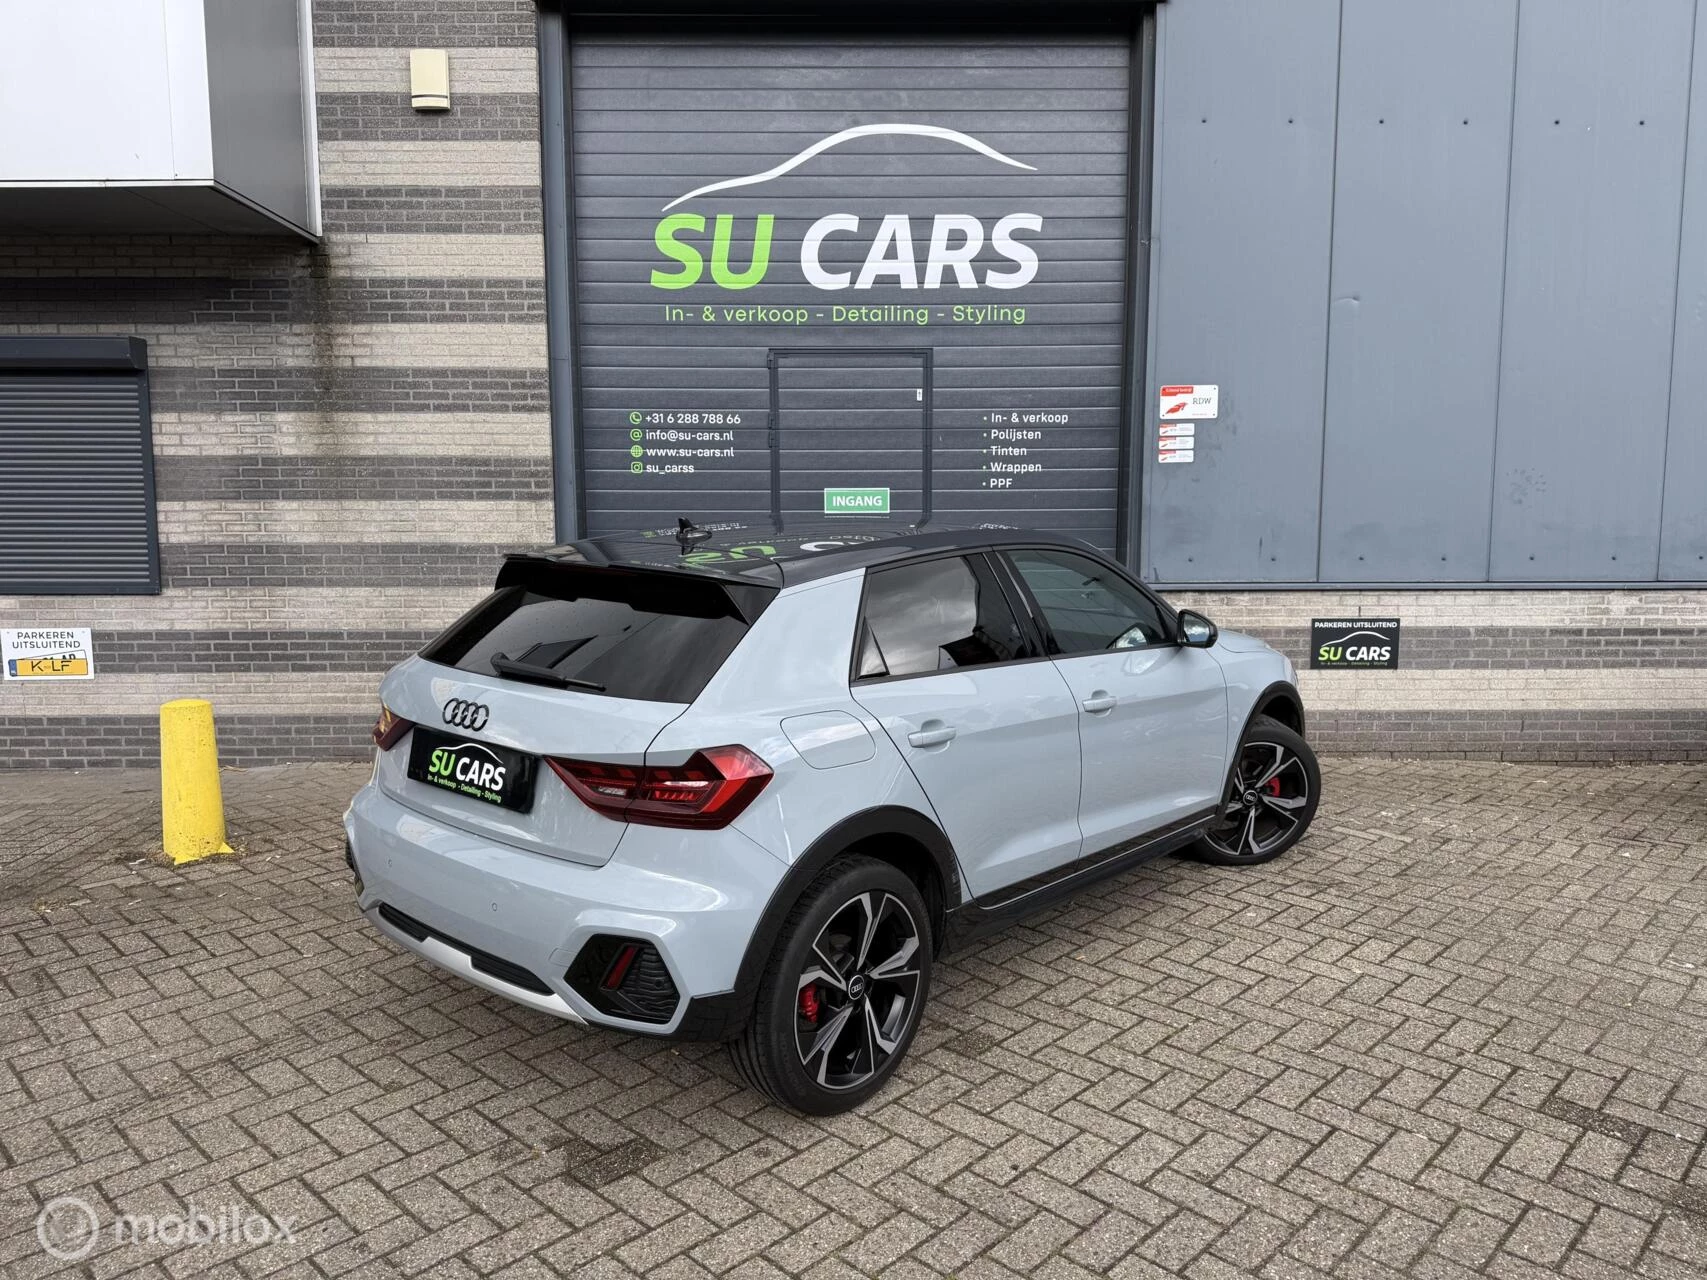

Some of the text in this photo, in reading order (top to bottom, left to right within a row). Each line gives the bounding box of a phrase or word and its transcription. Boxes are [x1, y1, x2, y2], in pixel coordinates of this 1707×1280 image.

[650, 213, 1044, 291] SU CARS
[665, 305, 694, 322] In-
[702, 305, 716, 322] &
[723, 304, 809, 325] verkoop
[833, 305, 929, 325] Detailing
[952, 304, 1027, 324] Styling
[645, 413, 741, 424] +31 6 288 788 66
[991, 412, 1069, 424] In- & verkoop
[646, 429, 734, 441] info@su-cars.nl
[990, 429, 1042, 442] Polijsten
[646, 446, 735, 458] www.su-cars.nl
[990, 445, 1028, 457] Tinten
[646, 463, 695, 475] su_carss
[990, 462, 1042, 474] Wrappen
[990, 478, 1013, 489] PPF
[832, 495, 883, 508] INGANG
[17, 631, 74, 639] PARKEREN
[12, 640, 80, 649] UITSLUITEND
[1318, 646, 1391, 661] SU CARS
[429, 749, 506, 791] SU CARS
